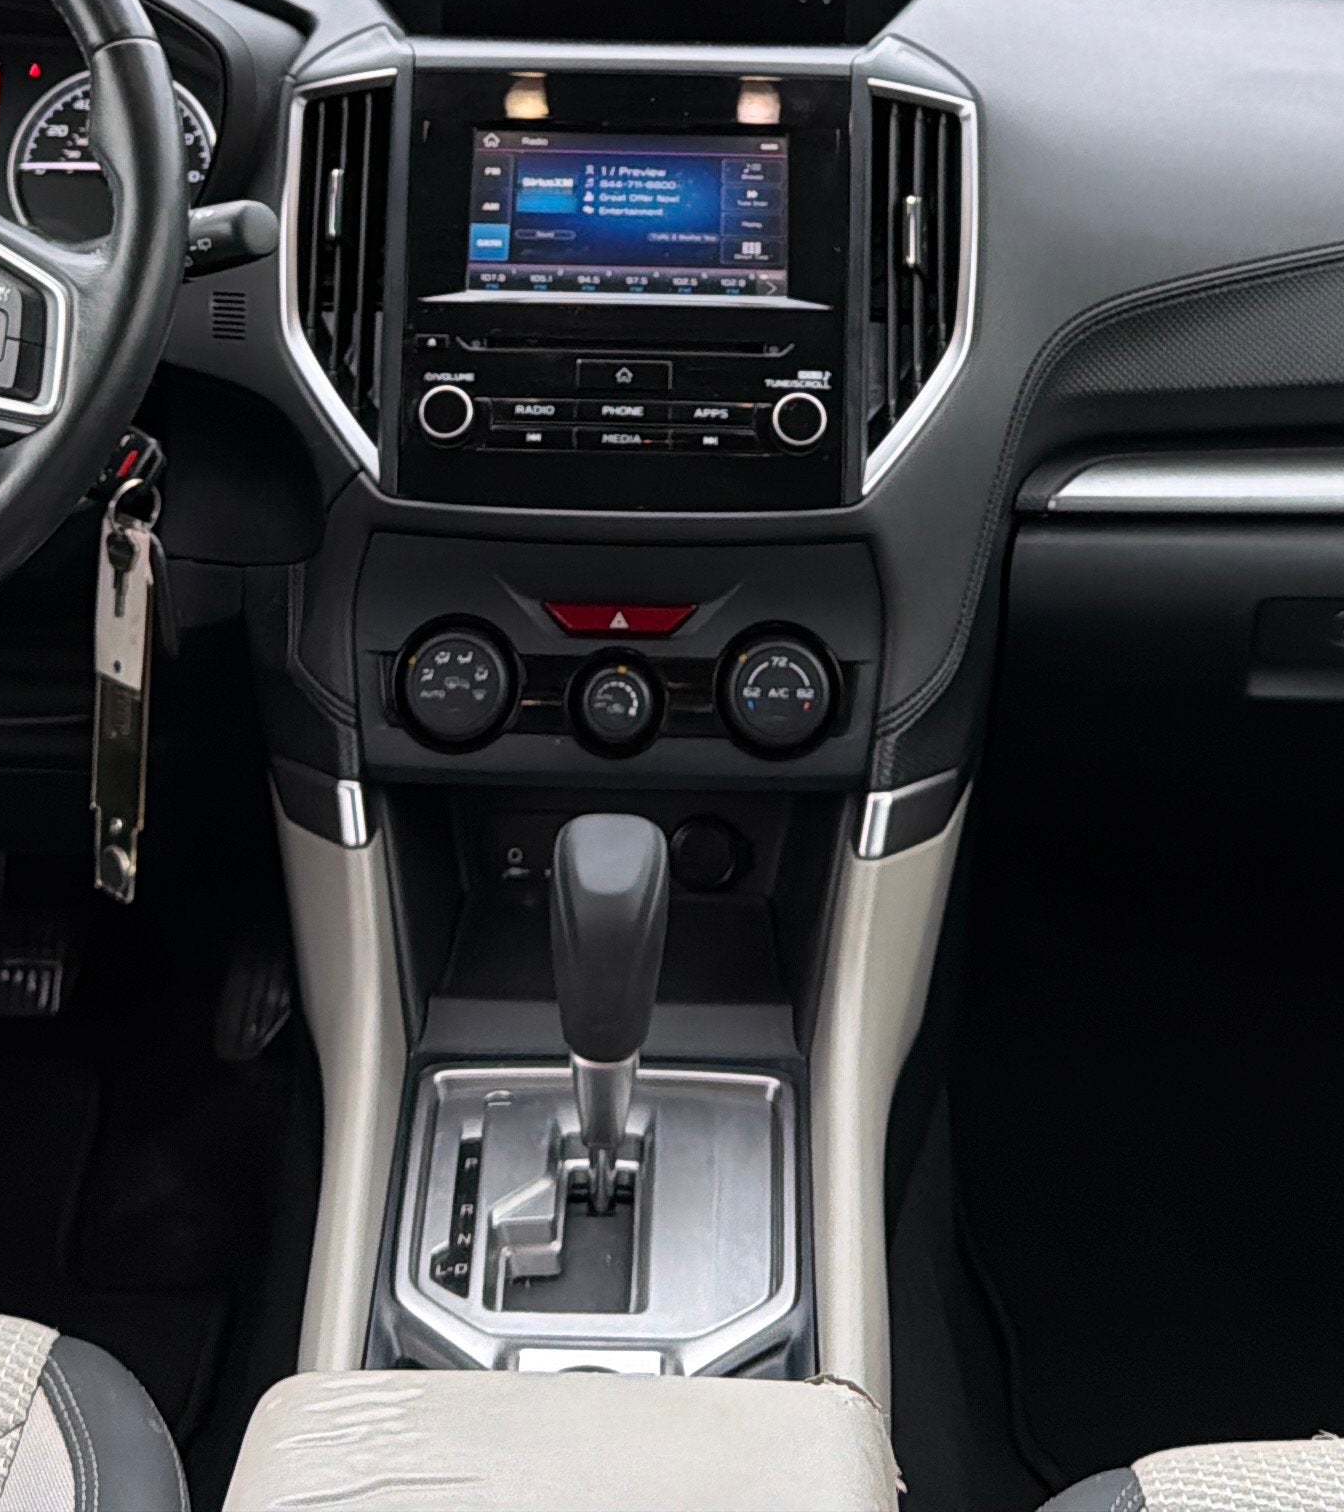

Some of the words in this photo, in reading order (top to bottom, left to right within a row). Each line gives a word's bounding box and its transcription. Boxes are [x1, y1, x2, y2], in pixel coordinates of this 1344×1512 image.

[45, 124, 69, 138] 20
[521, 136, 549, 147] Radio
[618, 166, 667, 178] Preview
[599, 192, 627, 202] Great
[481, 202, 501, 212] AM
[764, 378, 832, 390] TUNE/SCROLL
[514, 404, 555, 416] RADIO
[601, 405, 645, 417] PHONE
[693, 408, 729, 420] APPS
[601, 434, 642, 445] MEDIA
[770, 655, 789, 668] 72
[419, 689, 446, 699] AUTO
[768, 687, 790, 699] A/C
[464, 1157, 479, 1170] P
[459, 1203, 474, 1216] R
[457, 1233, 472, 1246] N
